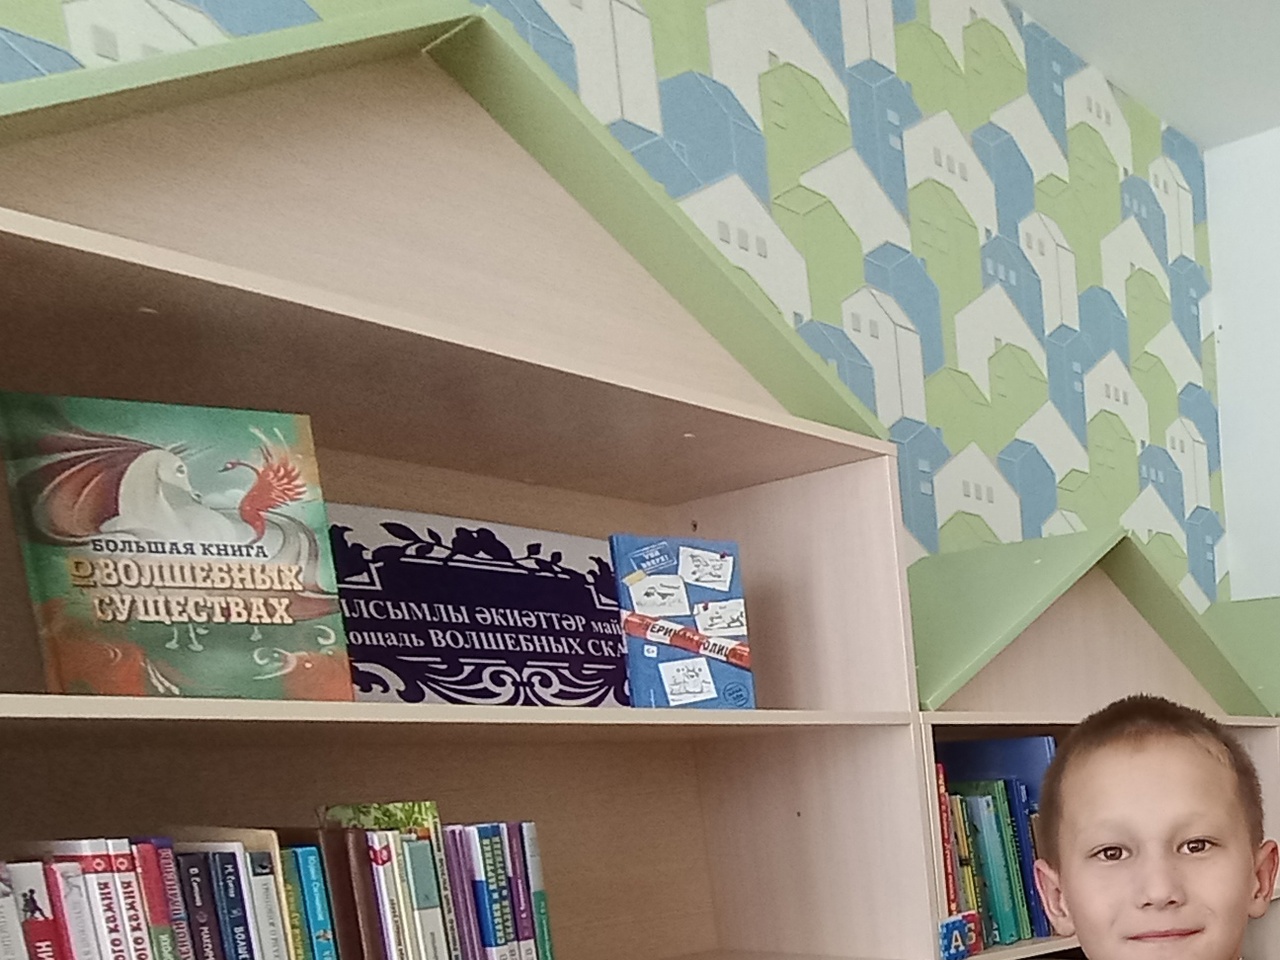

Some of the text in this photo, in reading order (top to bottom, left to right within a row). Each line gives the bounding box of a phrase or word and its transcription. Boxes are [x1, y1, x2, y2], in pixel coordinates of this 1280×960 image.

[91, 538, 268, 558] БОЛЬШАЯ КНИГА
[98, 558, 304, 592] ВОЛШЕБНЫХ
[94, 594, 295, 626] СУЩЕСТВАХ
[340, 599, 624, 636] ЛСЫМЛЫ ӘКИӘТТӘР май
[346, 628, 626, 658] ощадь ВОЛШЕБНЫХ СКА
[199, 925, 215, 960] МАКСИМ
[949, 930, 966, 954] А
